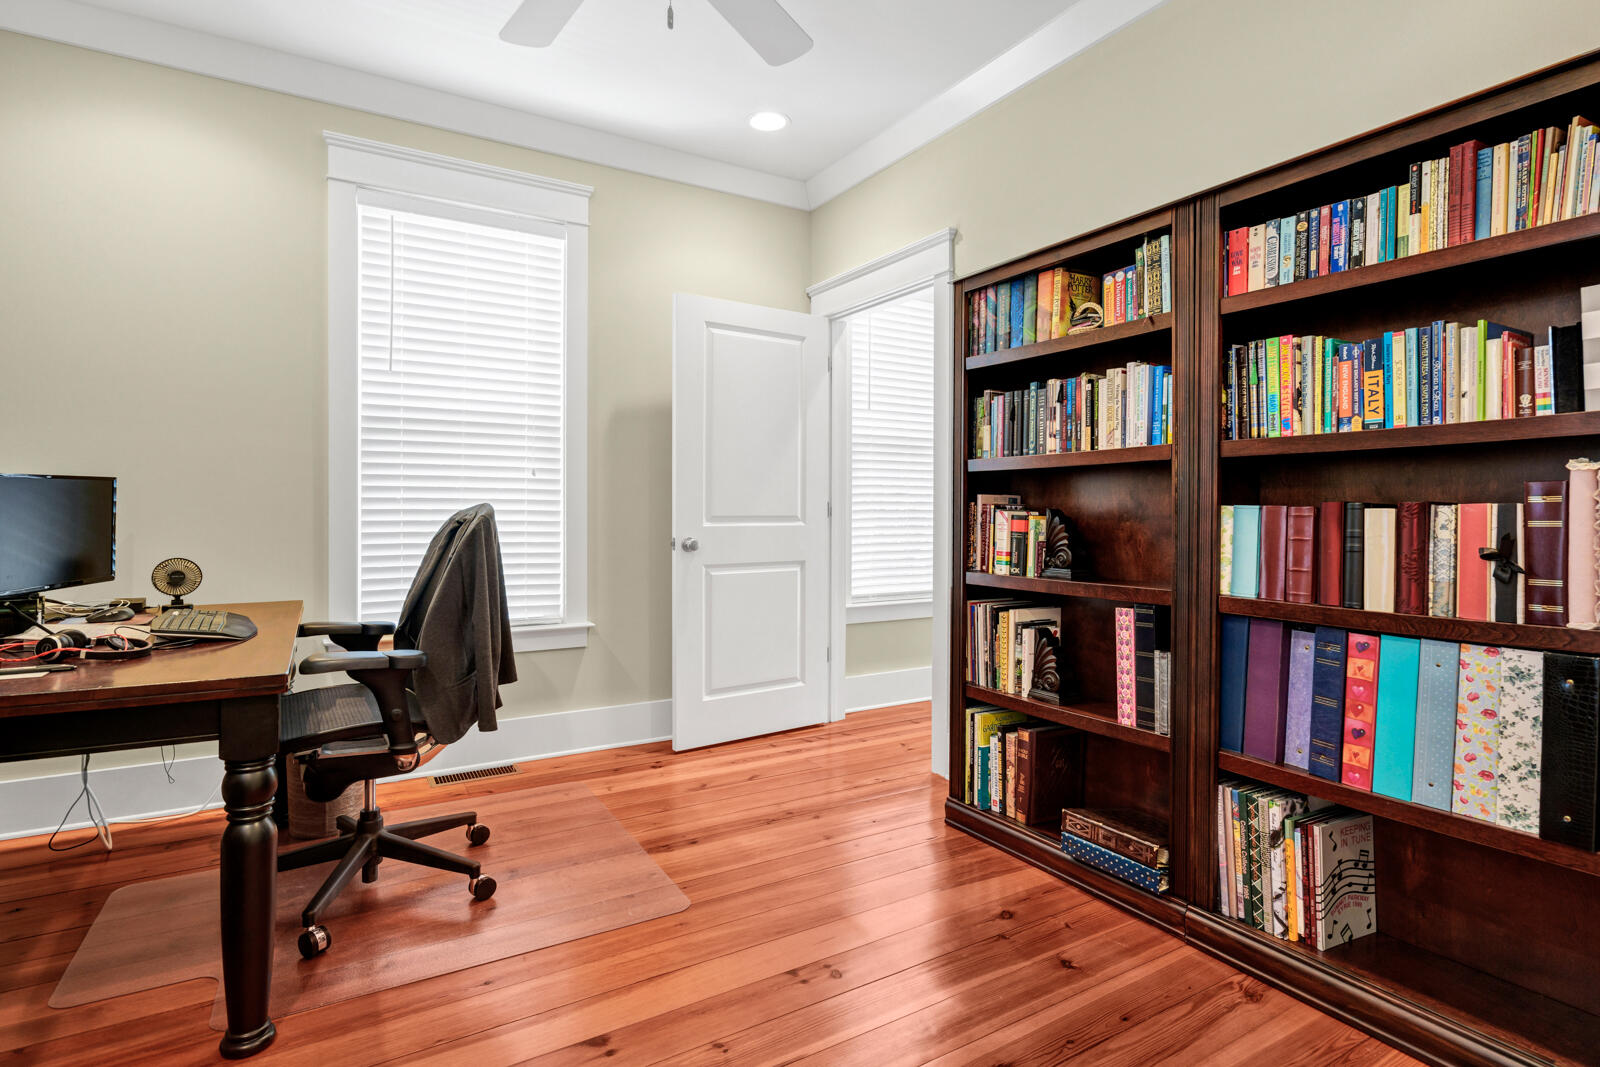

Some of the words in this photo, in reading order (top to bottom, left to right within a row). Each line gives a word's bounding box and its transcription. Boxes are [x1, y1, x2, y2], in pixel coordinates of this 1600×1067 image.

[1231, 250, 1243, 258] LOVE
[1266, 236, 1278, 273] CHARLESTON
[1070, 273, 1092, 284] HARRY
[1068, 282, 1092, 294] POTTER
[1368, 375, 1379, 415] ITALY
[1269, 394, 1278, 412] HARD
[1282, 387, 1290, 418] SEVEN
[1282, 418, 1291, 430] UP
[1340, 824, 1371, 836] KEEPING
[1341, 838, 1348, 848] IN
[1352, 832, 1371, 844] TUNE
